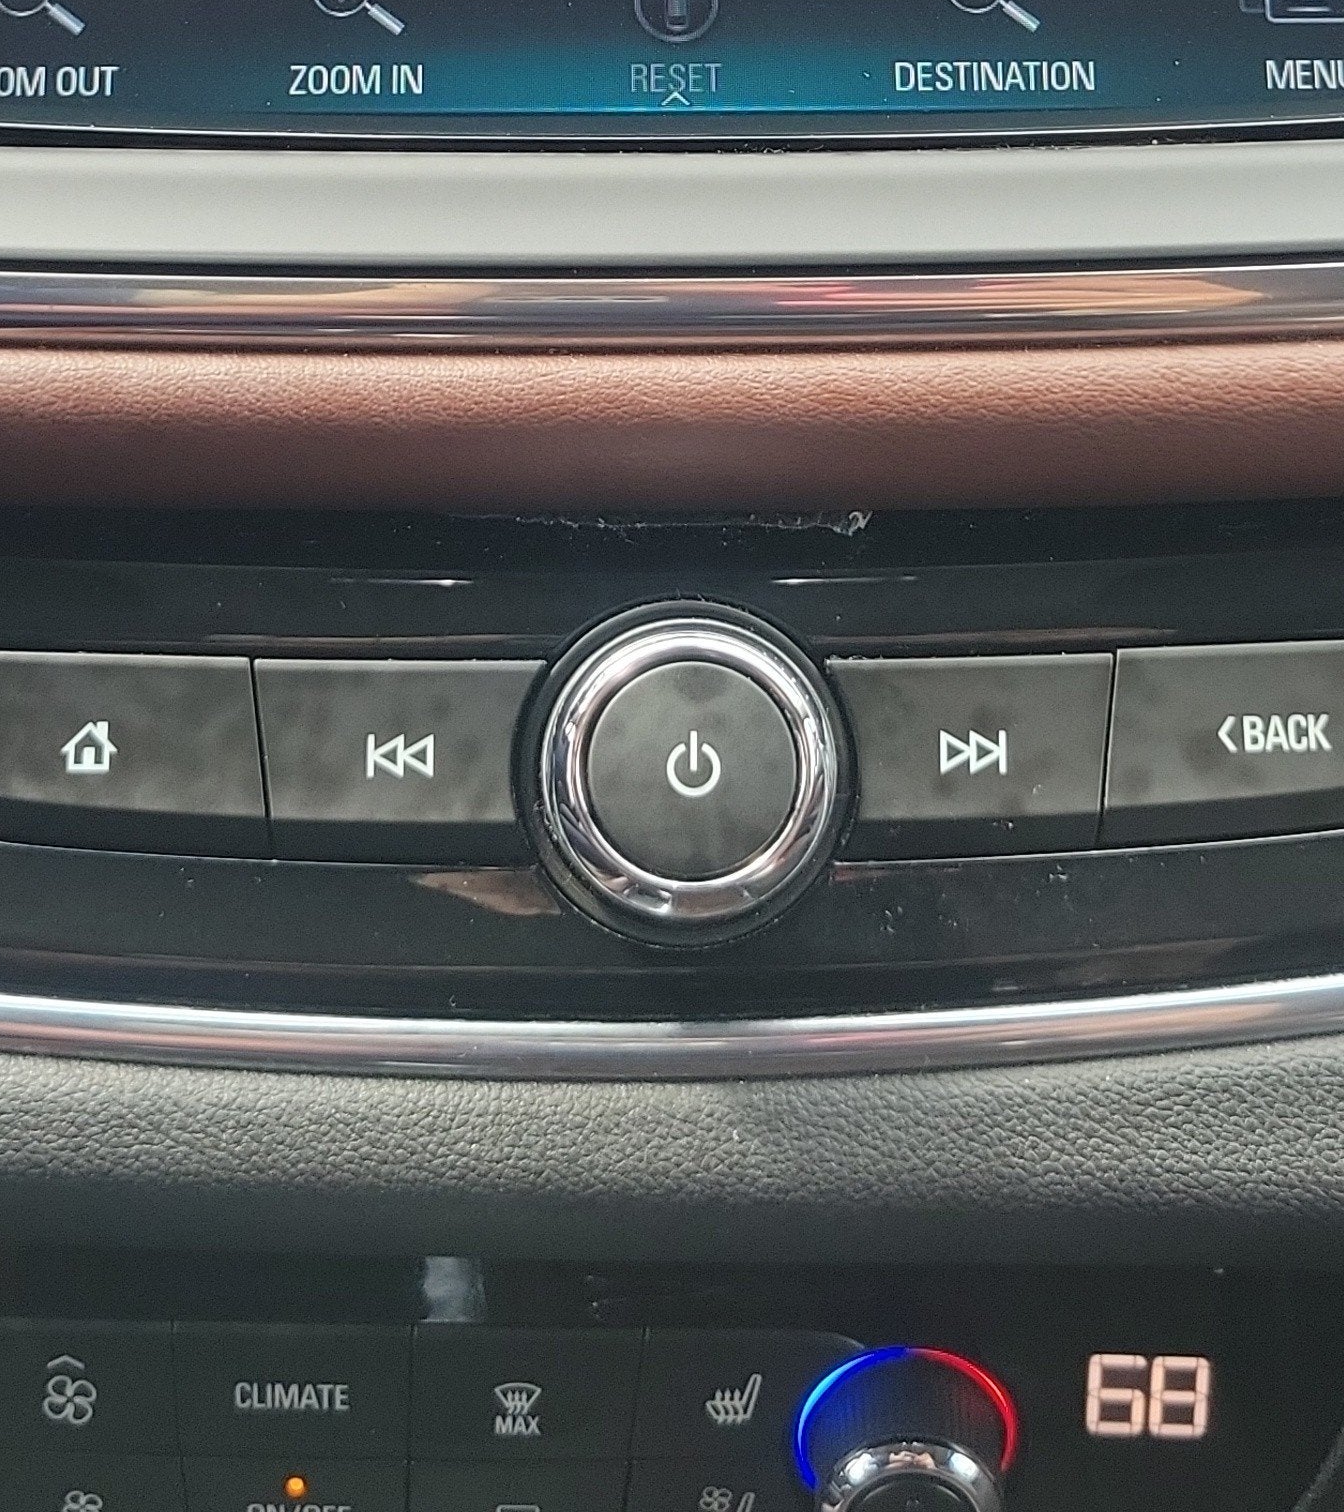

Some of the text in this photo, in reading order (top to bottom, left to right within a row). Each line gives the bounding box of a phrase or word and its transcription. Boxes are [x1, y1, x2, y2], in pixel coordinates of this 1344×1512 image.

[57, 66, 119, 97] OUT
[288, 64, 424, 96] ZOOM IN
[630, 63, 723, 93] RESET
[894, 61, 1096, 92] DESTINATION
[234, 1382, 351, 1412] CLIMATE
[1085, 1352, 1212, 1439] 68
[494, 1415, 541, 1436] MAX
